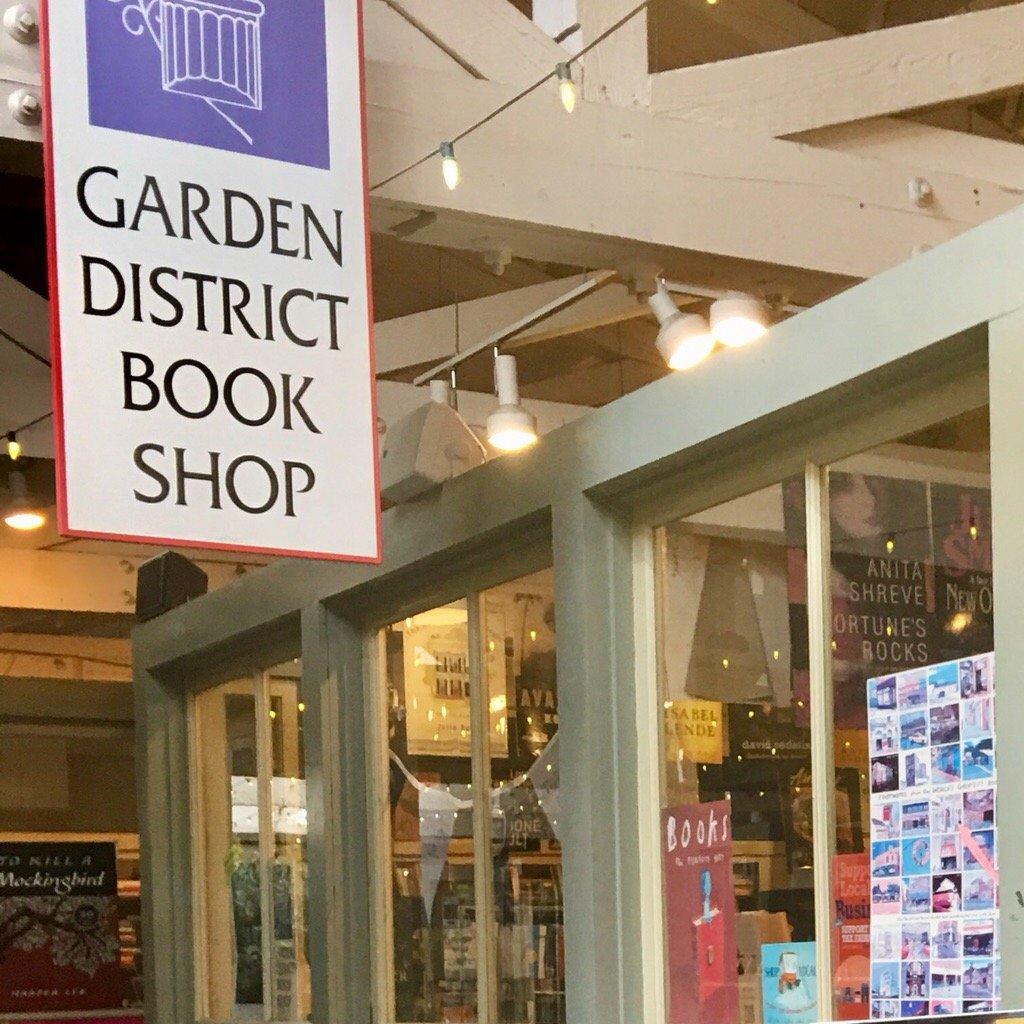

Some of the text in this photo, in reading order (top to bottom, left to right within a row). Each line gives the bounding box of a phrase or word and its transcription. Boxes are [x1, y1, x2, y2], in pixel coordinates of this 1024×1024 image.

[76, 165, 343, 267] GARDEN
[80, 255, 349, 350] DISTRICT
[121, 351, 322, 434] BOOK
[133, 443, 316, 517] SHOP
[867, 558, 923, 580] ANITA
[850, 581, 924, 606] SHREVE
[980, 587, 992, 614] O
[834, 613, 926, 638] ORTUNE'S
[862, 640, 928, 662] ROCKS
